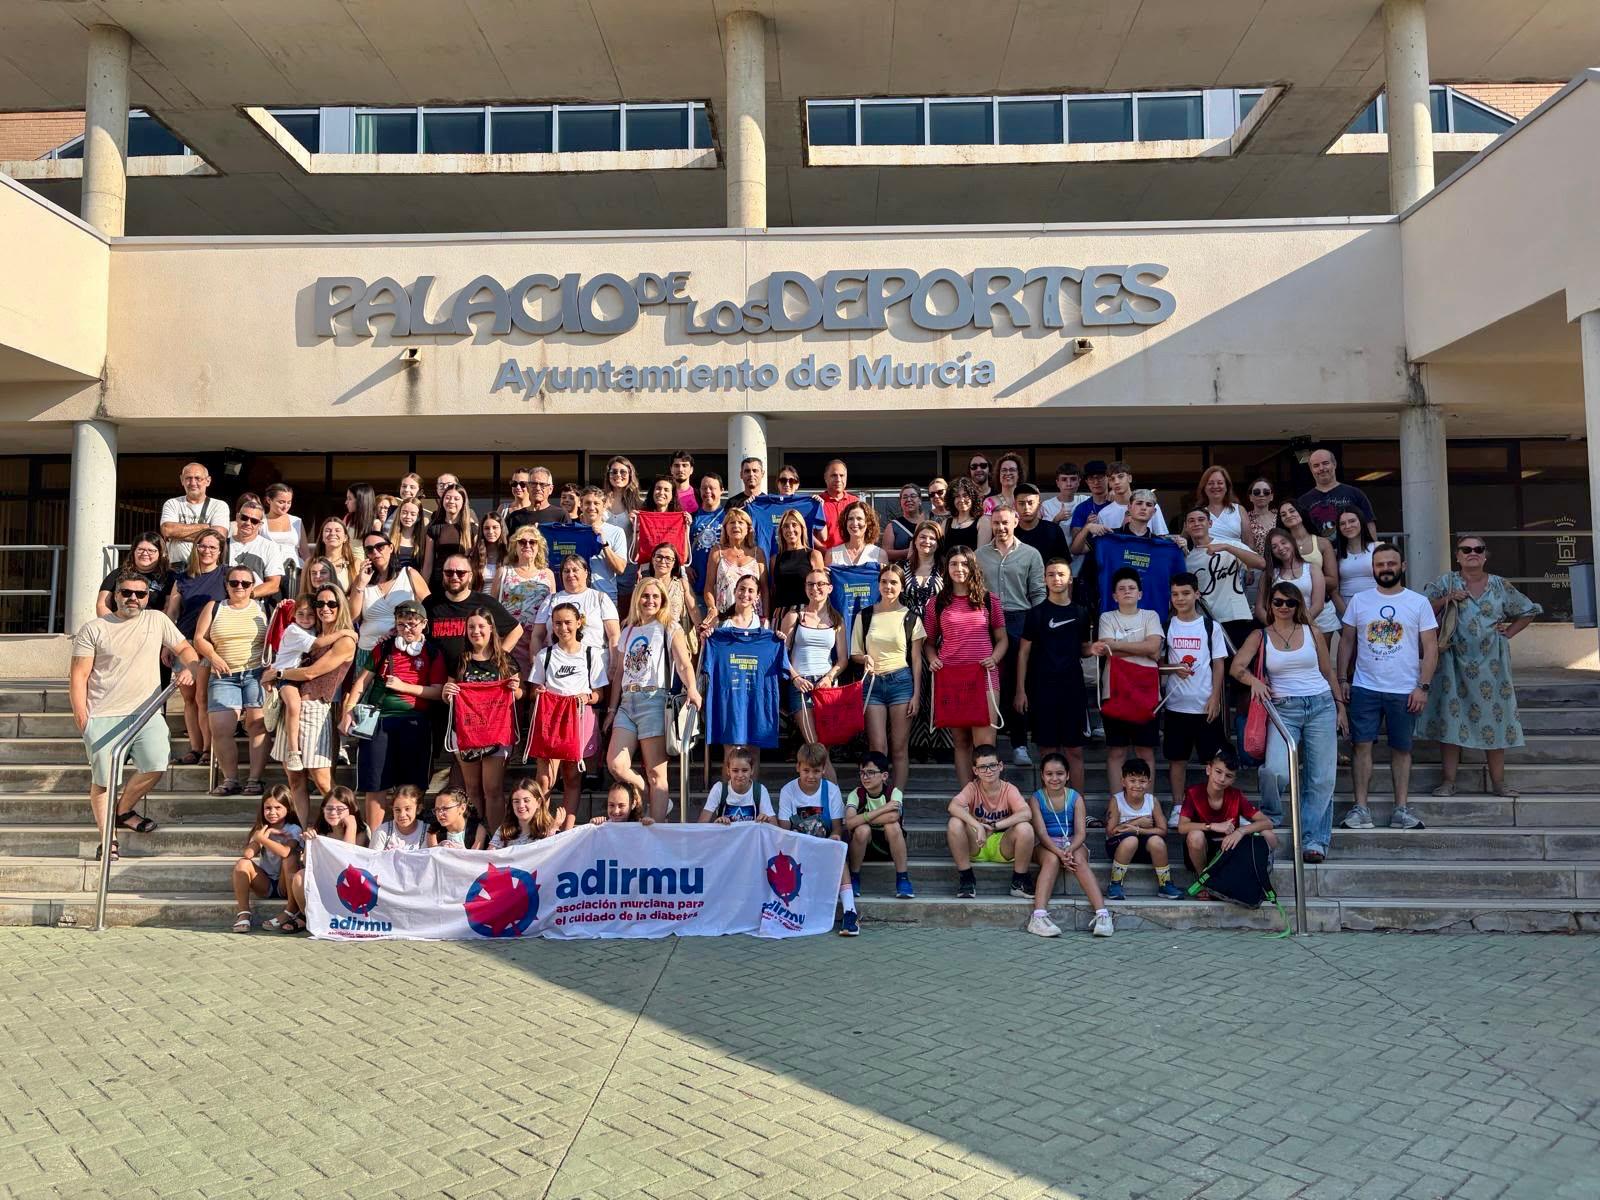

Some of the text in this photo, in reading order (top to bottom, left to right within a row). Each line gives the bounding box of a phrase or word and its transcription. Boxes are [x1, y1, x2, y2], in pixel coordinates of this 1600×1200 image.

[315, 263, 1177, 336] PALACIO DE LOS DEPORTES
[497, 351, 996, 398] Ayuntamiento de Murcia
[1544, 572, 1568, 580] Ayunta
[432, 617, 466, 637] MARV
[1173, 639, 1200, 649] ADIRMU
[559, 665, 576, 673] NIKE
[556, 859, 704, 899] adirmu
[555, 899, 705, 913] asociación murciana para
[329, 916, 393, 932] adirmu
[555, 915, 566, 926] el
[568, 912, 616, 923] cuidado
[619, 911, 633, 920] de
[636, 912, 647, 920] la
